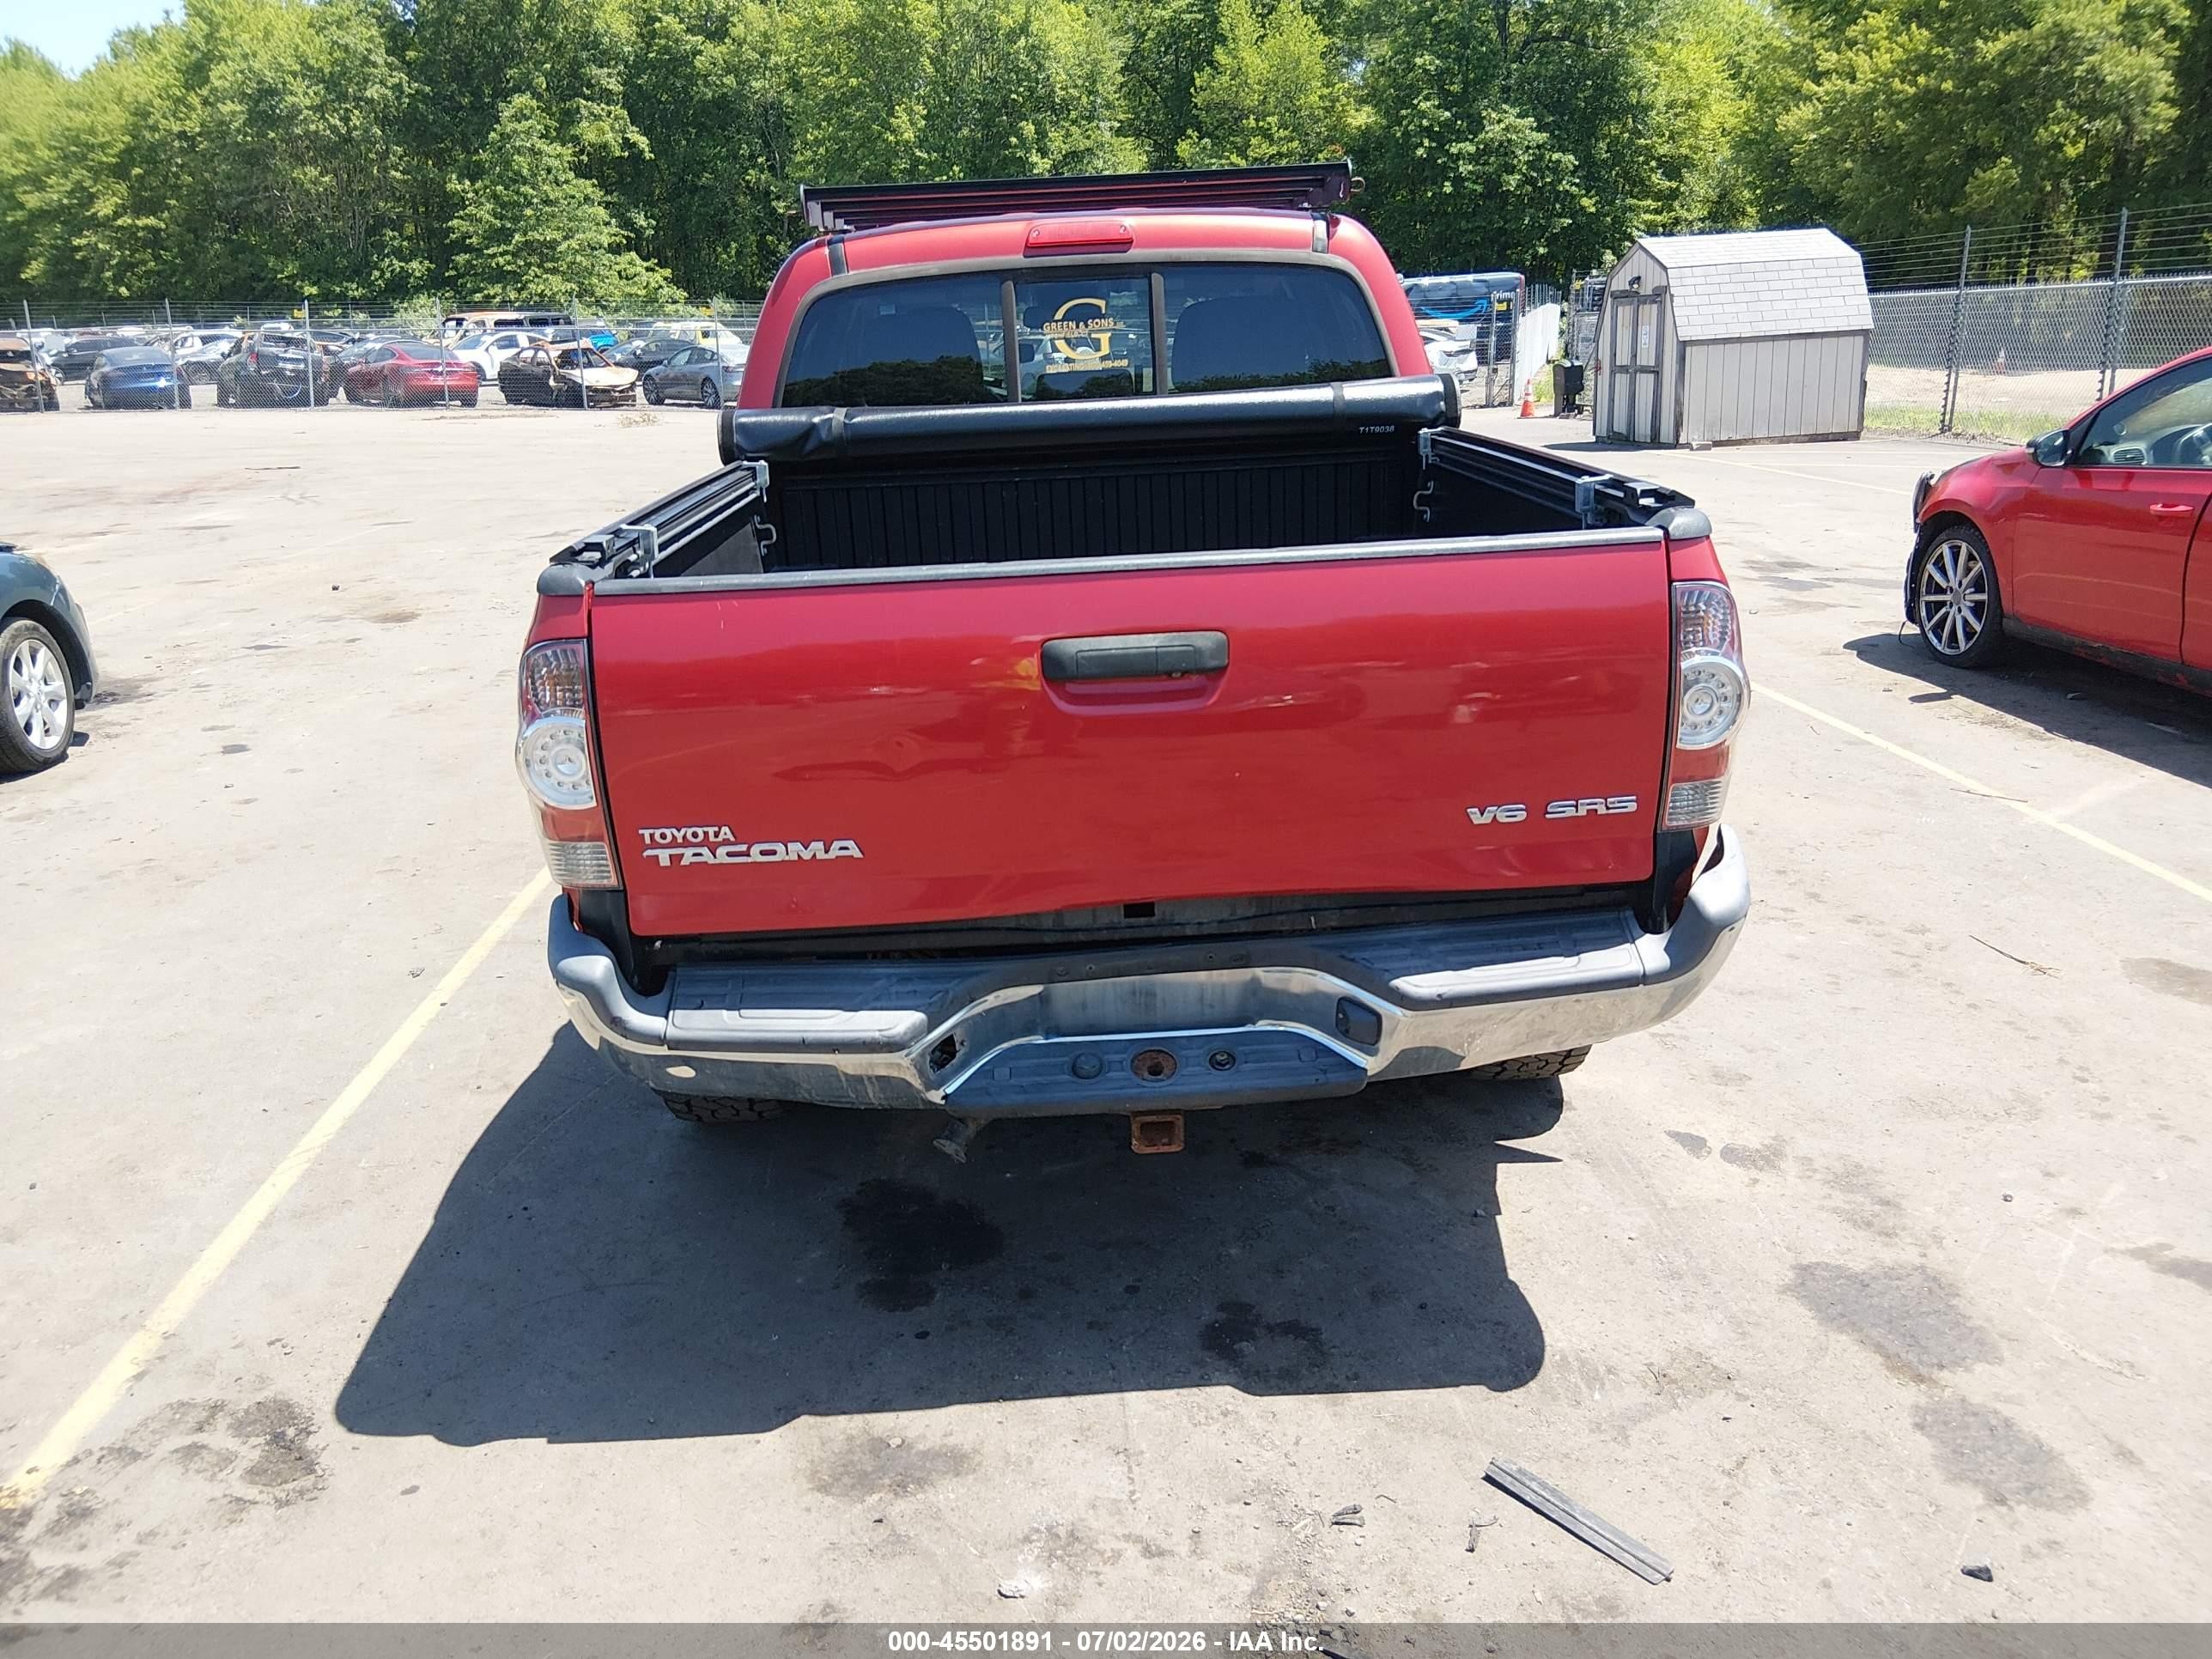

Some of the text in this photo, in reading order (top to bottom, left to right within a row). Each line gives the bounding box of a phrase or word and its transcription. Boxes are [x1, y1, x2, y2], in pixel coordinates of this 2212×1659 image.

[1042, 320, 1077, 332] GREEN
[1087, 318, 1115, 328] SONS
[1467, 795, 1638, 824] V6 SR5
[639, 825, 736, 844] TOYOTA
[642, 839, 864, 866] TACOMA
